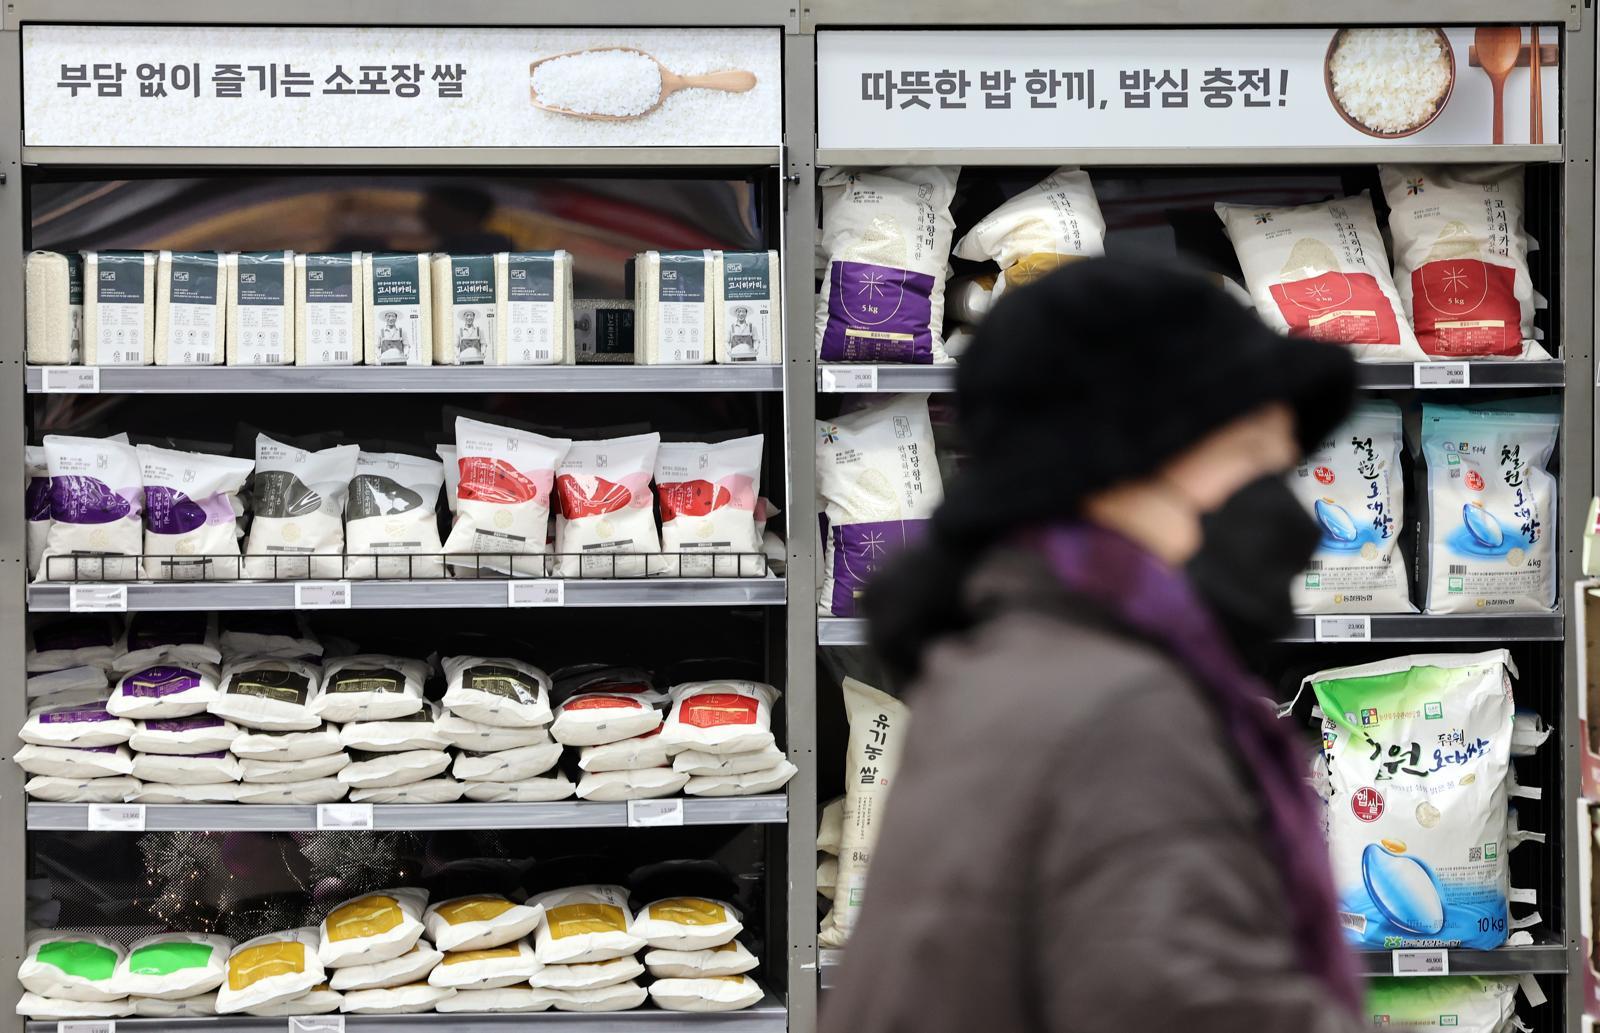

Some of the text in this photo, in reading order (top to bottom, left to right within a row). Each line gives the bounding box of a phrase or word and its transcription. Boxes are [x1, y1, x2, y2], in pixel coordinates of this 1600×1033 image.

[57, 62, 467, 98] 부담 없이 즐기는 소포장 쌀
[861, 67, 1289, 110] 따뜻한 밥 한끼, 밥심 충전!
[1345, 222, 1366, 266] 고시히카리
[1494, 199, 1510, 258] 고시히카리
[377, 284, 412, 295] 고시히카리
[456, 284, 489, 294] 고시히카리
[728, 281, 762, 290] 고시히카리
[907, 443, 924, 494] 명당향미
[864, 712, 891, 761] 유기농
[1428, 736, 1491, 773] 오대쌀
[860, 766, 880, 785] 쌀
[1356, 787, 1384, 815] 햅쌀
[1477, 917, 1505, 933] 10 kg
